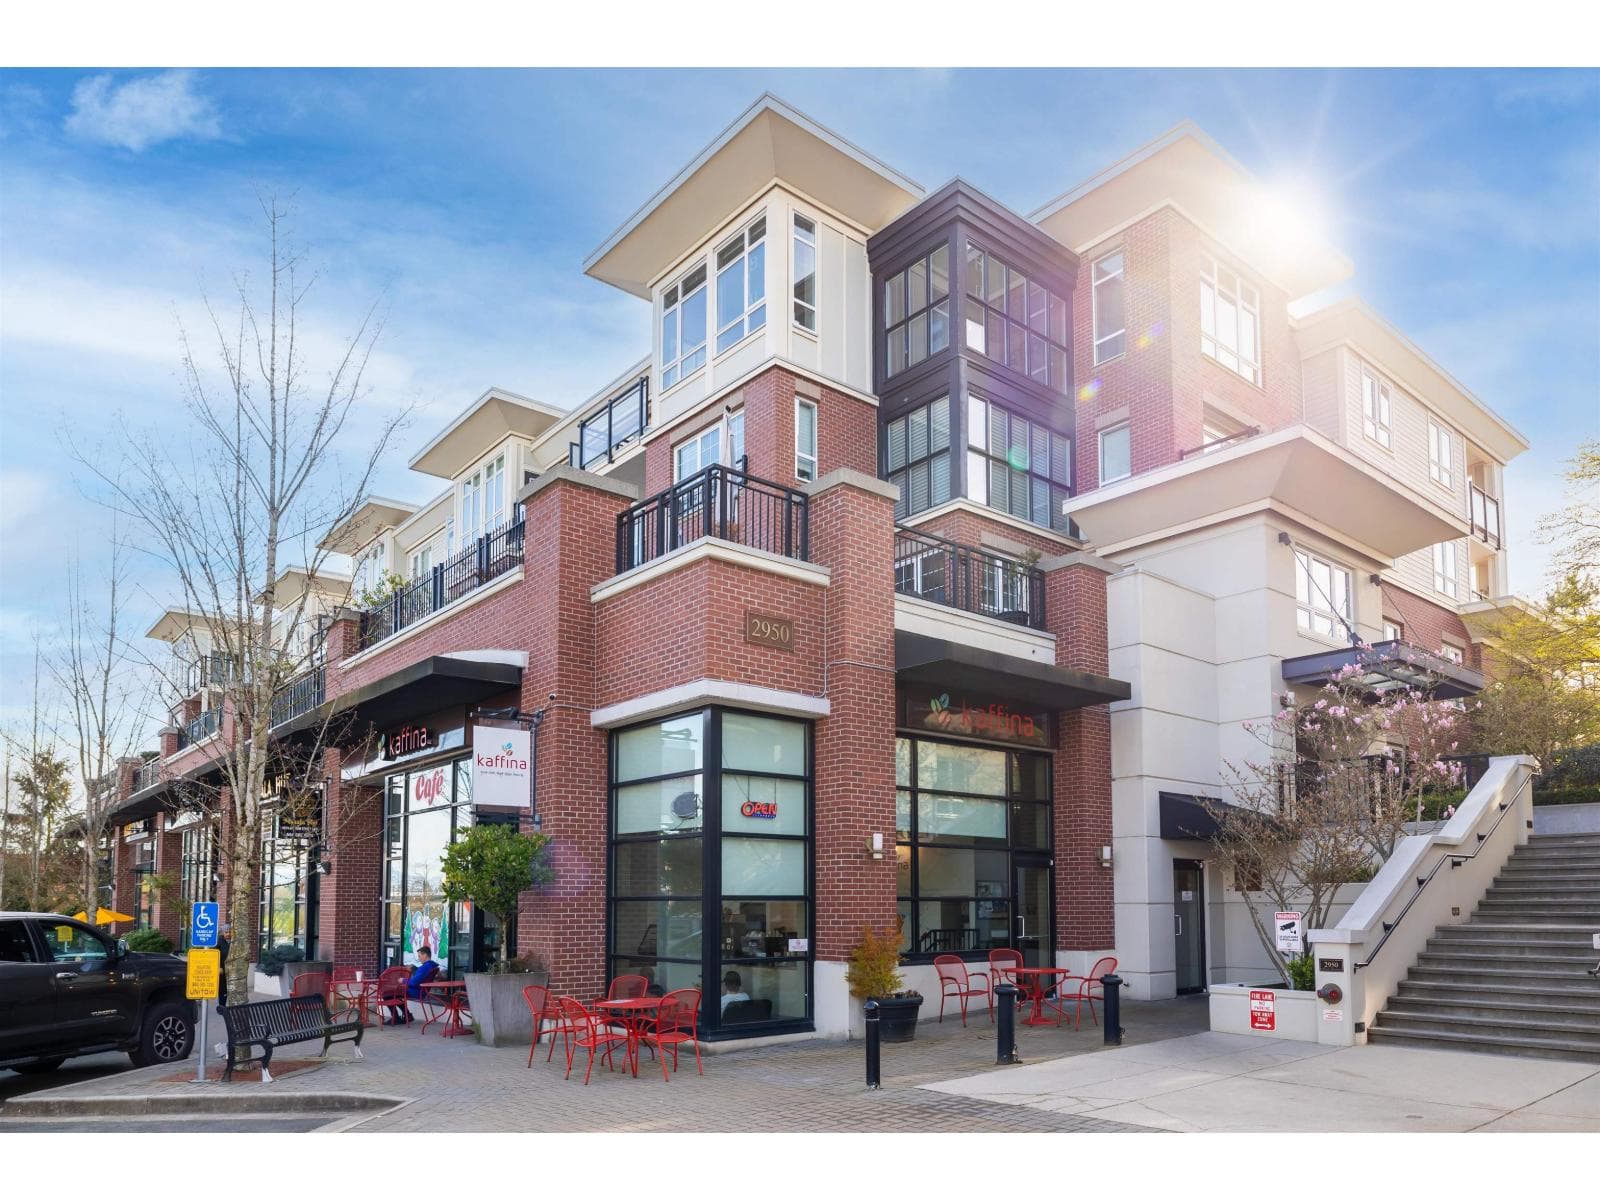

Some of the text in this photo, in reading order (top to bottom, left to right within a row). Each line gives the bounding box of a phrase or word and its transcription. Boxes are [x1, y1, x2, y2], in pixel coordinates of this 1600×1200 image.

[751, 619, 790, 643] 2950
[961, 700, 1035, 737] kaffina
[389, 726, 427, 756] kaffina
[477, 753, 527, 770] kaffina
[415, 768, 444, 806] Café
[741, 801, 777, 817] OPEN
